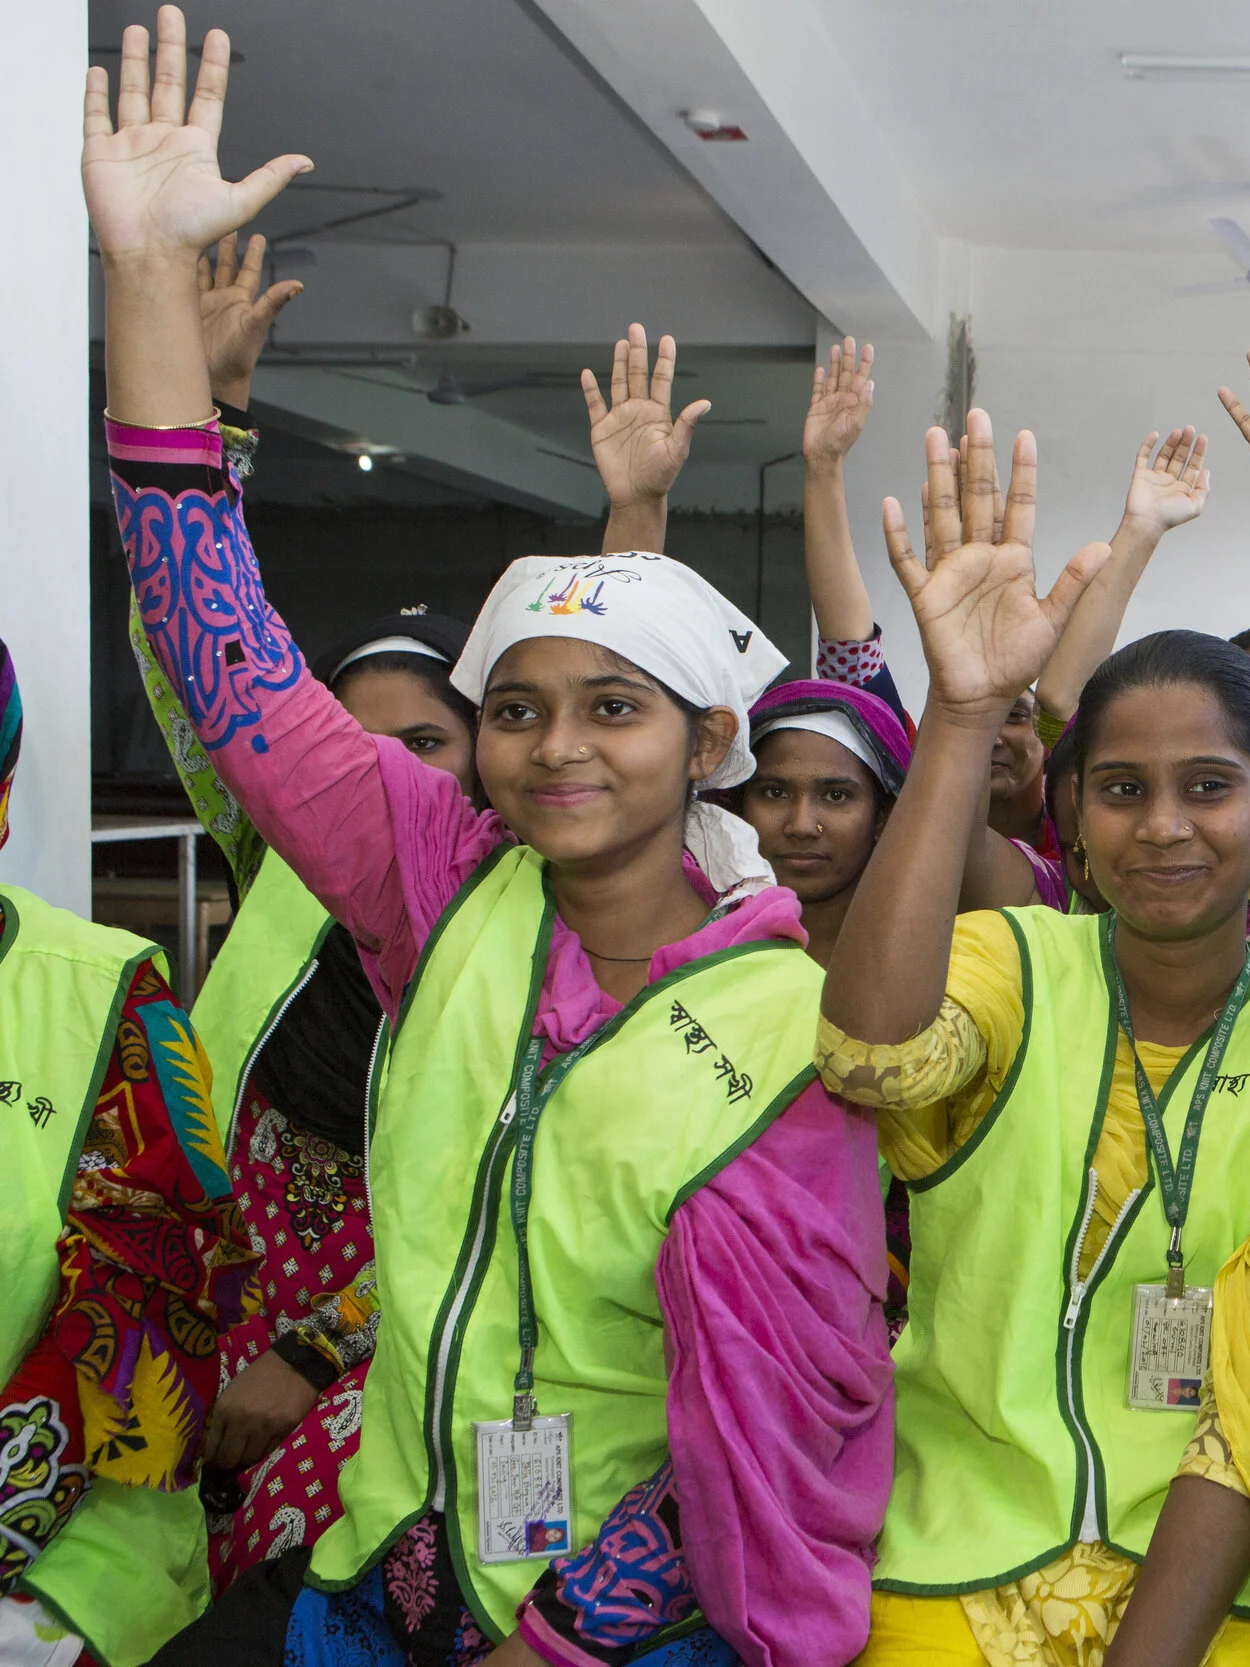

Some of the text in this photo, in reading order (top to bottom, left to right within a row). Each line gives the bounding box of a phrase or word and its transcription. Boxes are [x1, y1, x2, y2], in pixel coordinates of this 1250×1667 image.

[561, 1050, 580, 1068] APS
[1207, 1023, 1230, 1069] COMPOSITE
[714, 1053, 753, 1105] সখী
[1198, 1072, 1212, 1090] KNIT
[1193, 1094, 1205, 1110] APS
[1140, 1090, 1154, 1110] KNIT
[1147, 1113, 1169, 1167] COMPOSITE
[516, 1134, 532, 1196] COMPOSITE
[515, 1200, 527, 1224] KNIT
